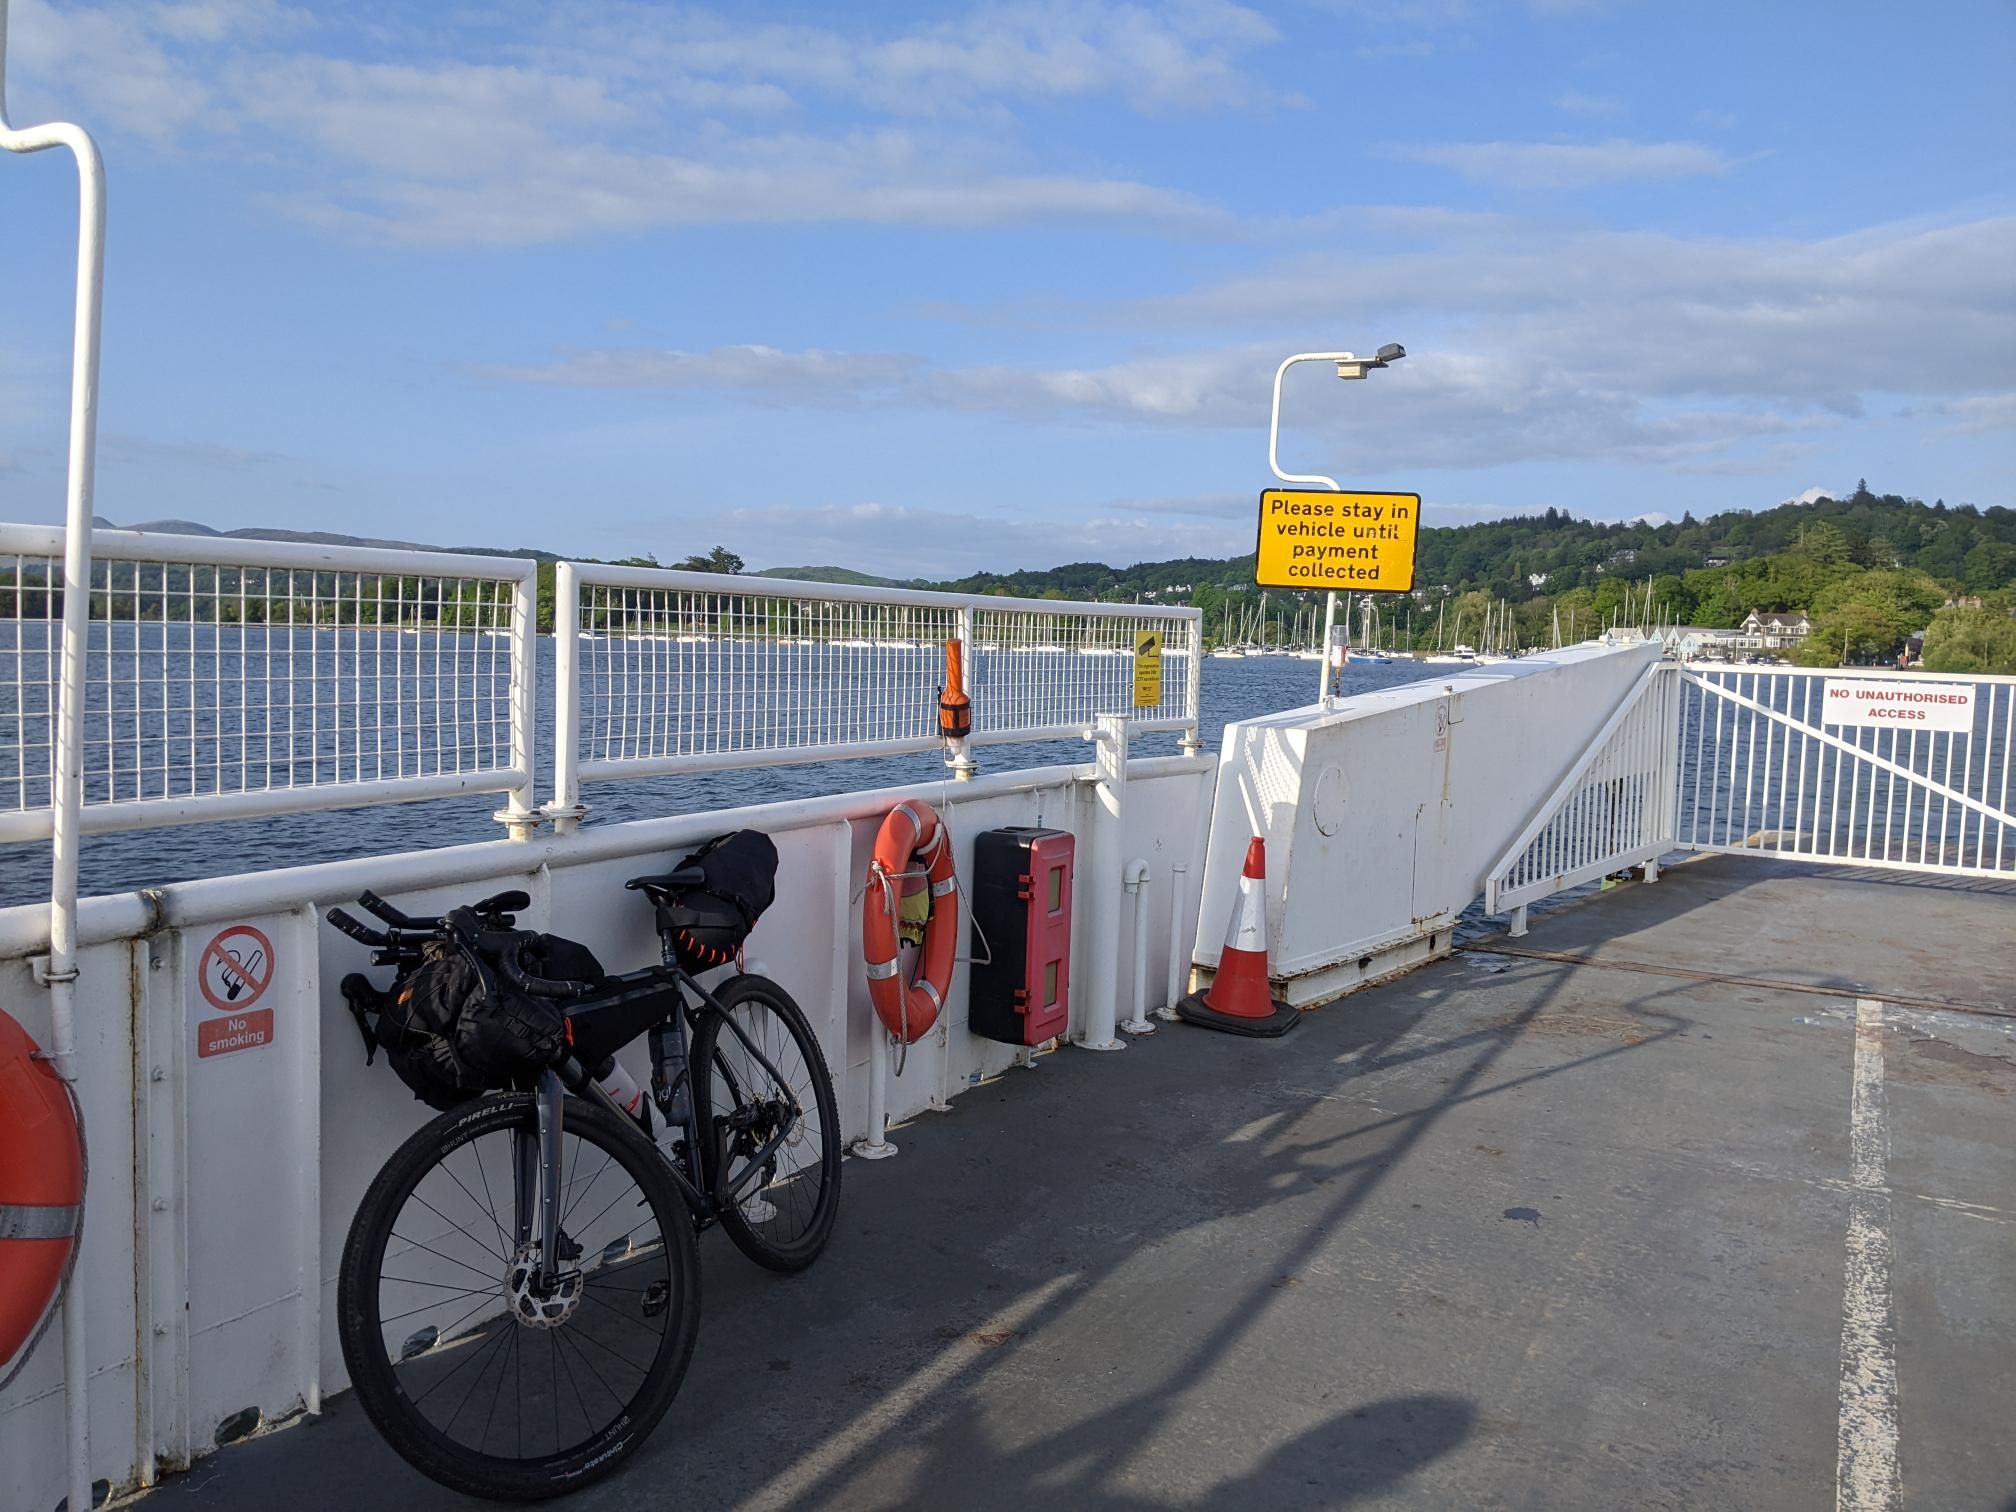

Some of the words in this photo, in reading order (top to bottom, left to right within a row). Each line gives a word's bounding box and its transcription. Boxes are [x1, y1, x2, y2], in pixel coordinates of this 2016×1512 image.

[1271, 499, 1335, 517] Please
[1342, 502, 1384, 521] stay
[1391, 503, 1409, 519] in
[1276, 521, 1346, 538] vehicle
[1353, 524, 1399, 540] until
[1292, 543, 1379, 560] payment
[1288, 562, 1380, 580] collected
[1829, 688, 1850, 699] NO
[1855, 690, 1968, 705] UNAUTHORISED
[1868, 707, 1926, 721] ACCESS
[228, 1018, 247, 1032] No
[208, 1030, 265, 1052] smoking
[457, 1102, 514, 1128] PIRELLI
